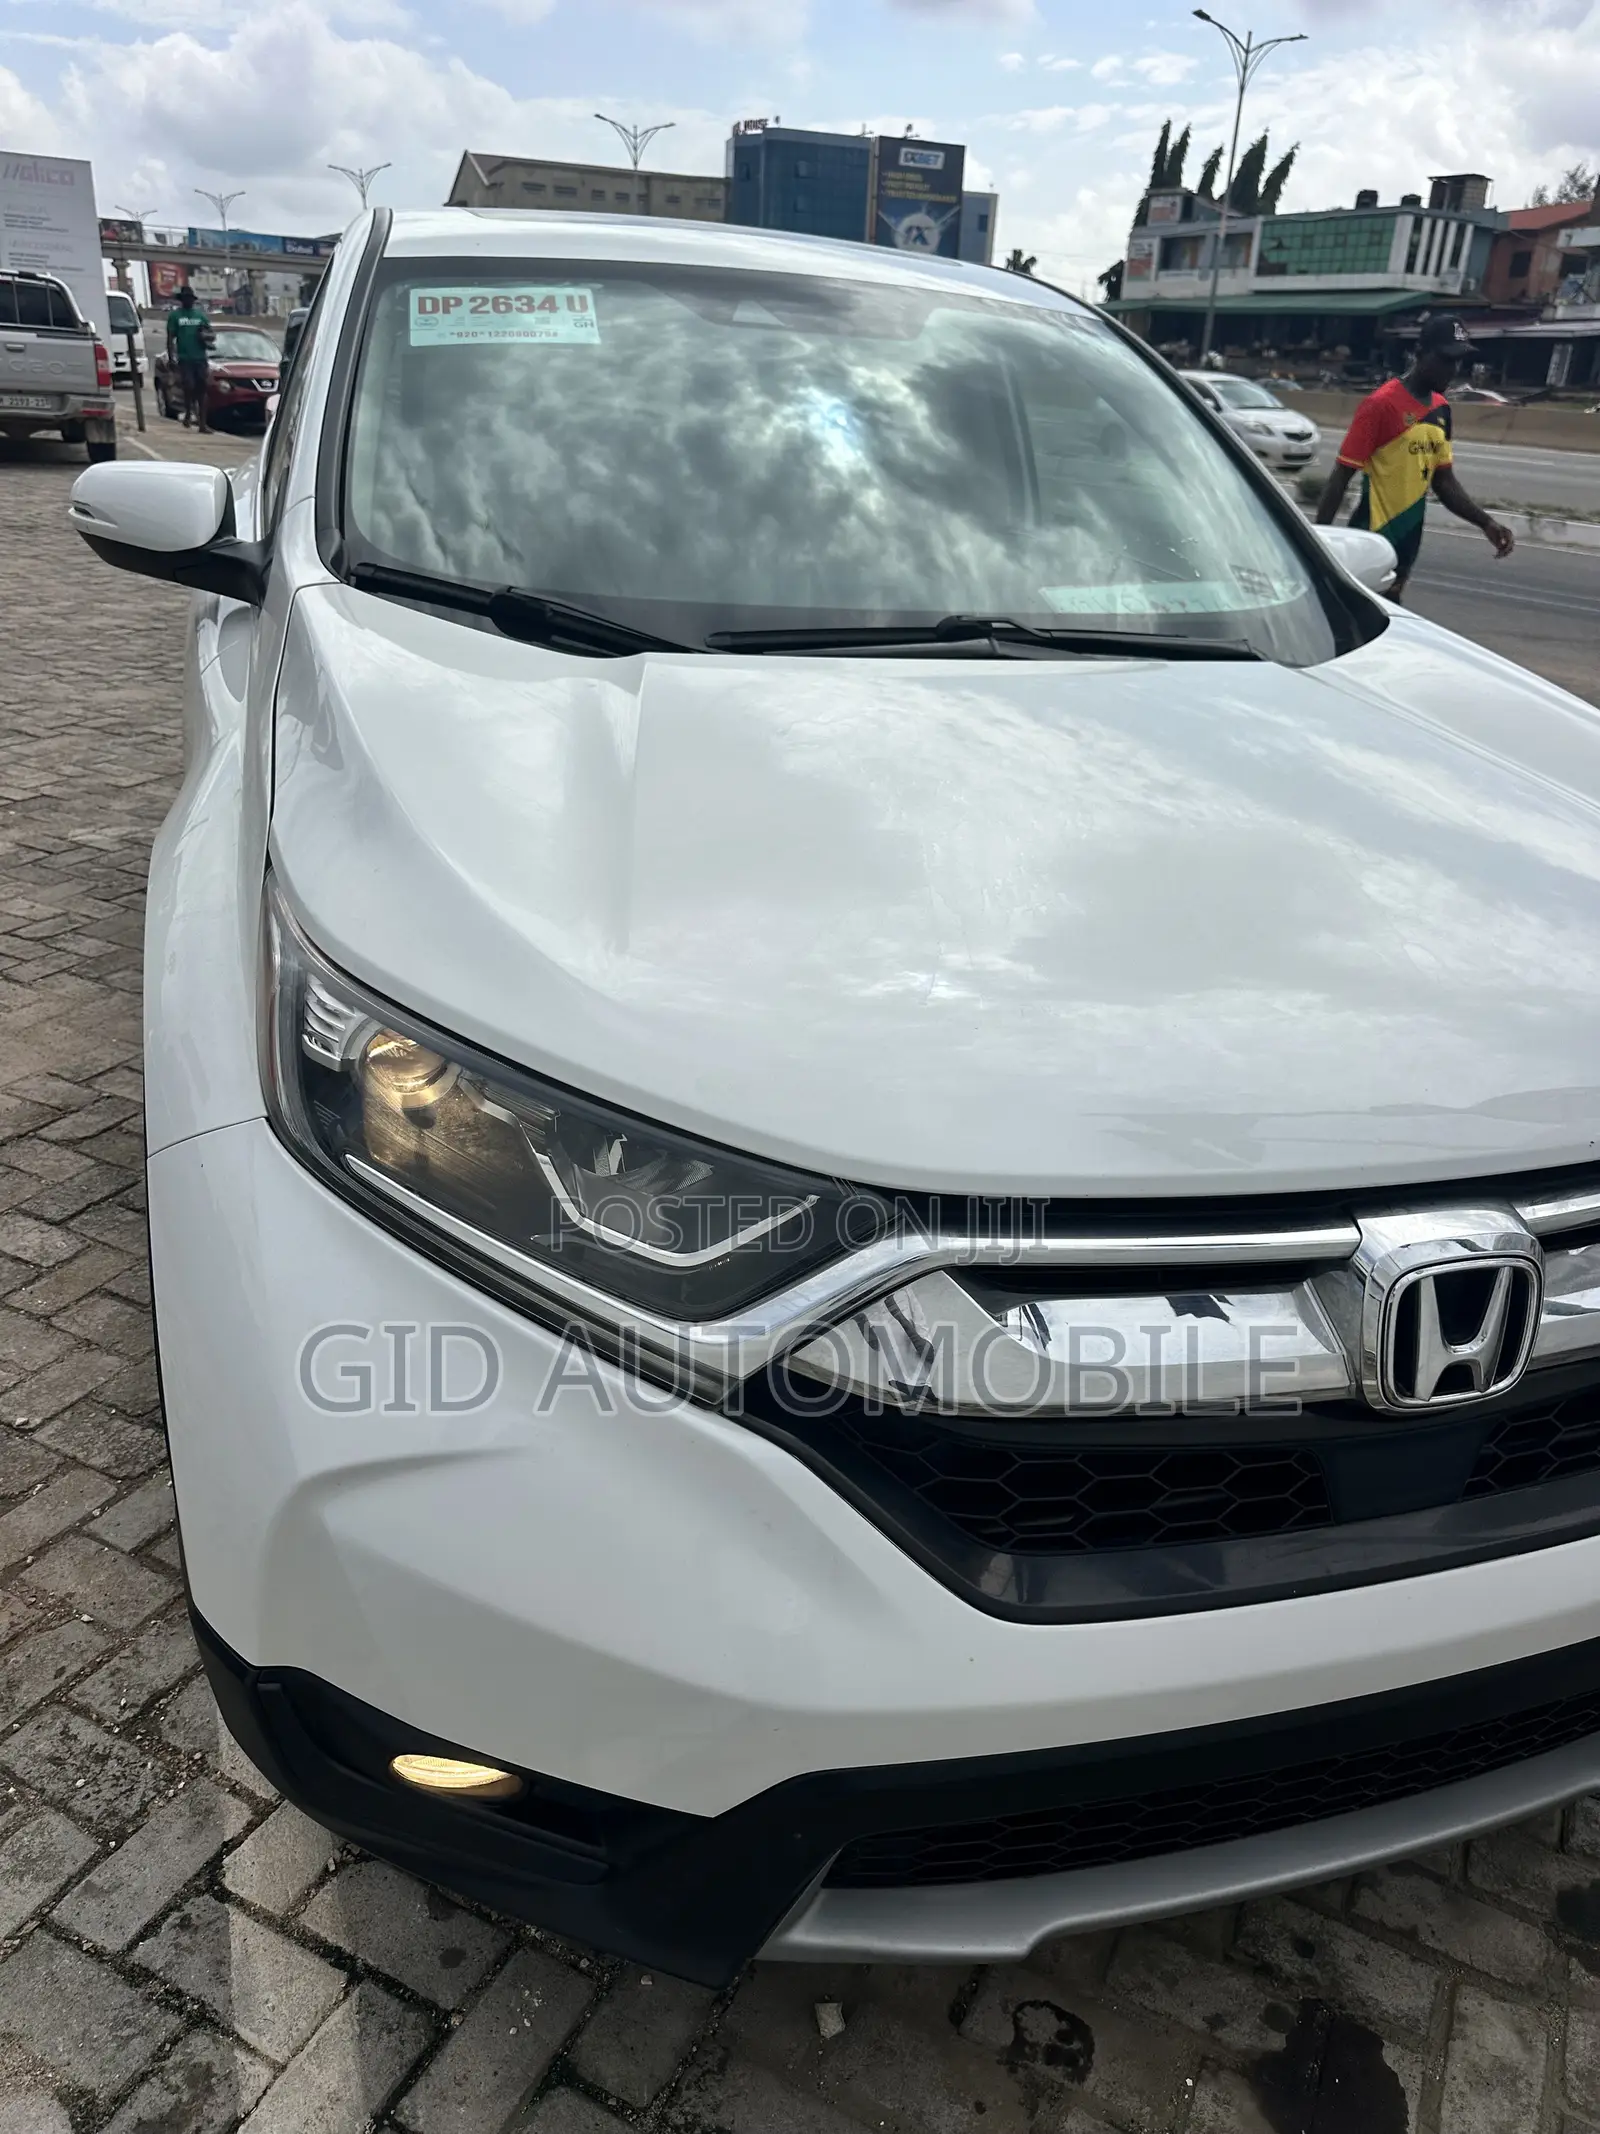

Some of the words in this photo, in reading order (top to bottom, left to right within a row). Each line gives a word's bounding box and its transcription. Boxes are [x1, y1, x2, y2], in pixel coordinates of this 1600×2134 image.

[417, 296, 464, 315] DP
[469, 294, 560, 315] 2634
[566, 294, 589, 314] U
